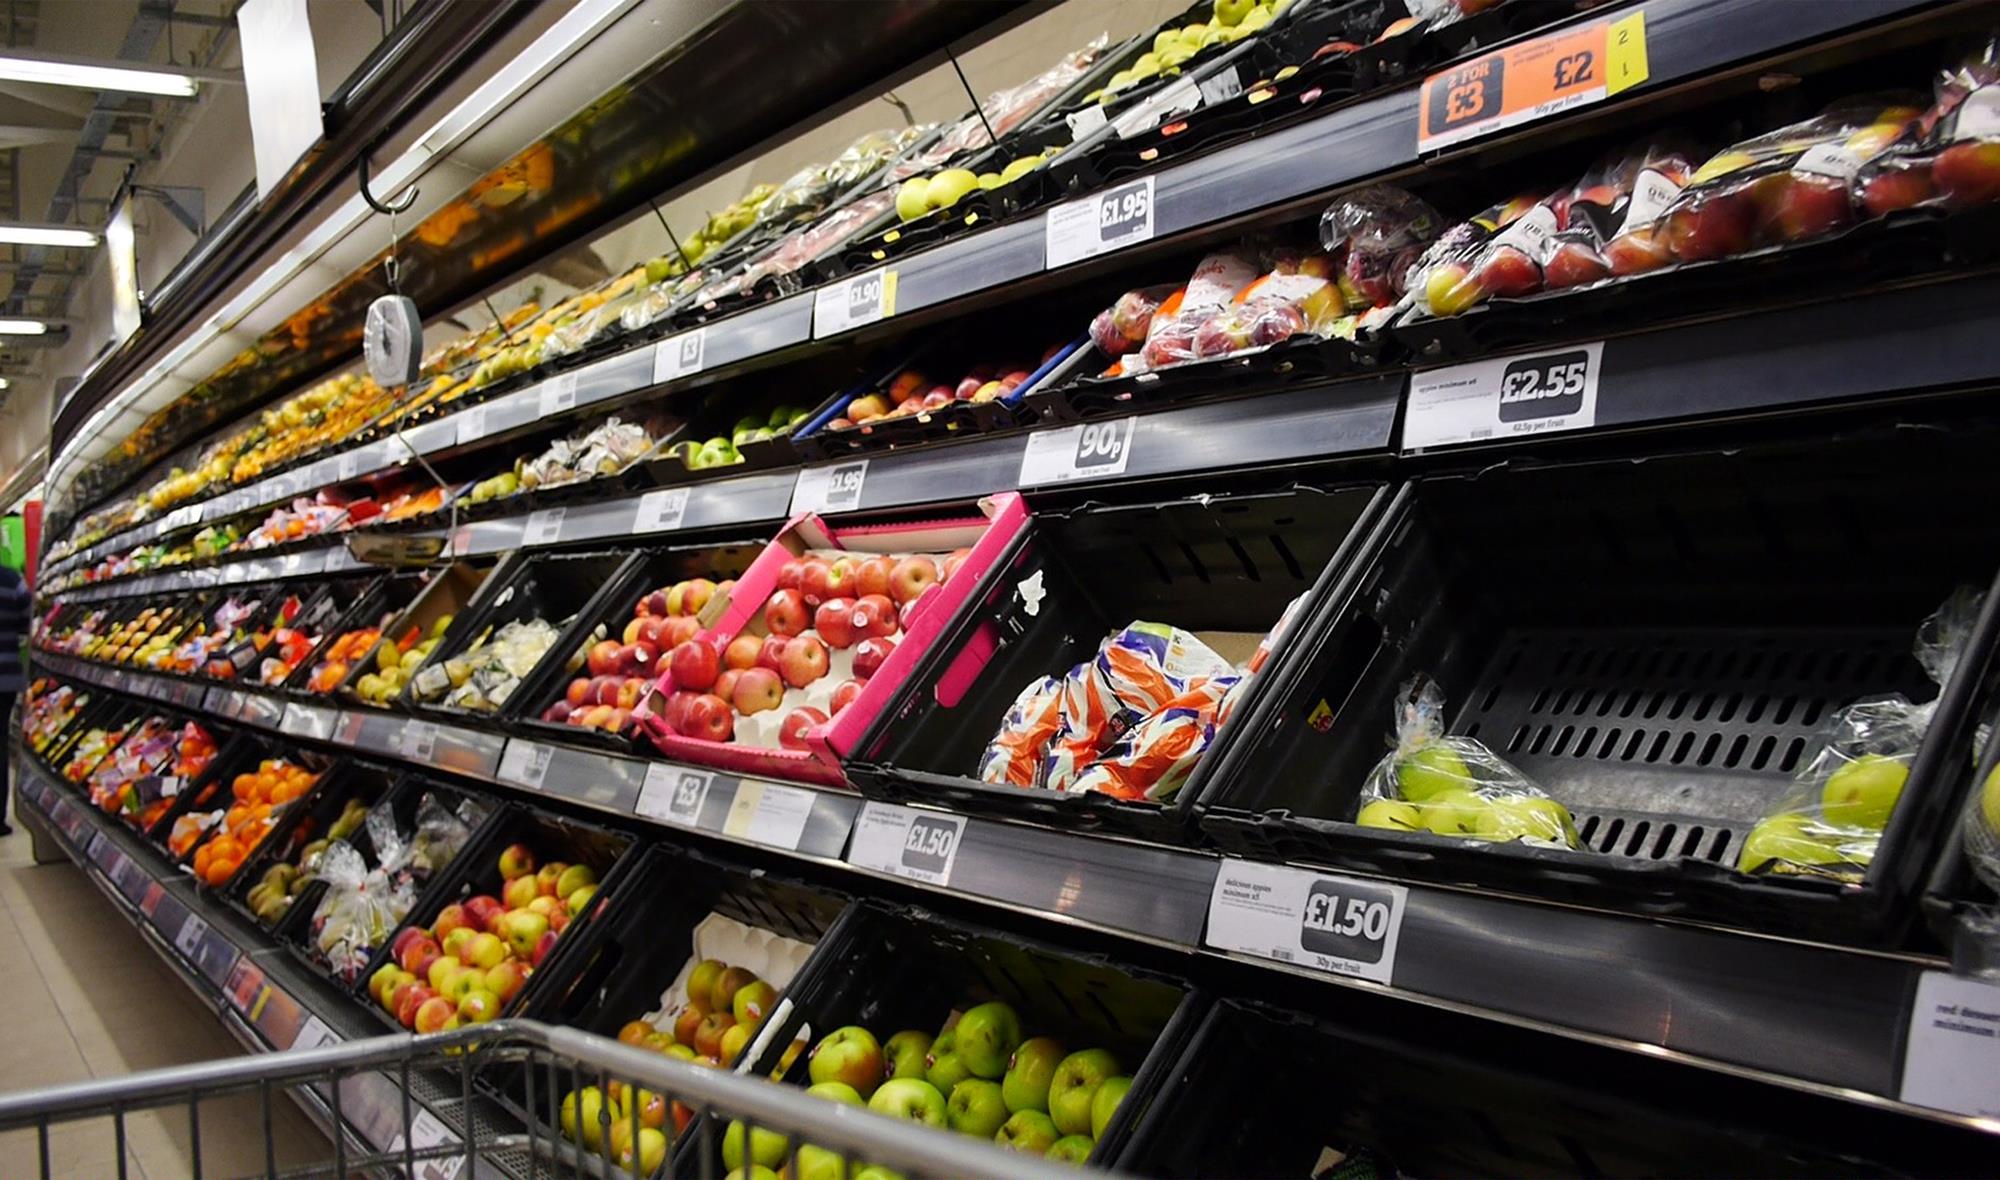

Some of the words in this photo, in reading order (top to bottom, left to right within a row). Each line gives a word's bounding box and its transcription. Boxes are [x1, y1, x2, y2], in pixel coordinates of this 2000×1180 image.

[1618, 30, 1628, 45] 2
[1448, 74, 1457, 88] 2
[1461, 62, 1489, 84] FOR
[1553, 51, 1593, 90] £2
[1446, 80, 1485, 123] £3
[1101, 189, 1147, 228] £1.95
[850, 280, 880, 307] £1.90
[1501, 362, 1586, 404] £2.55
[1533, 420, 1546, 431] per
[1547, 417, 1565, 428] fruit
[1080, 424, 1121, 459] 90p
[676, 777, 700, 806] £3
[906, 825, 953, 857] £1.50
[1223, 888, 1250, 899] minimum
[1304, 892, 1389, 941] £1.50
[1316, 956, 1329, 967] 30p
[1330, 959, 1343, 970] per
[1343, 961, 1361, 974] fruit
